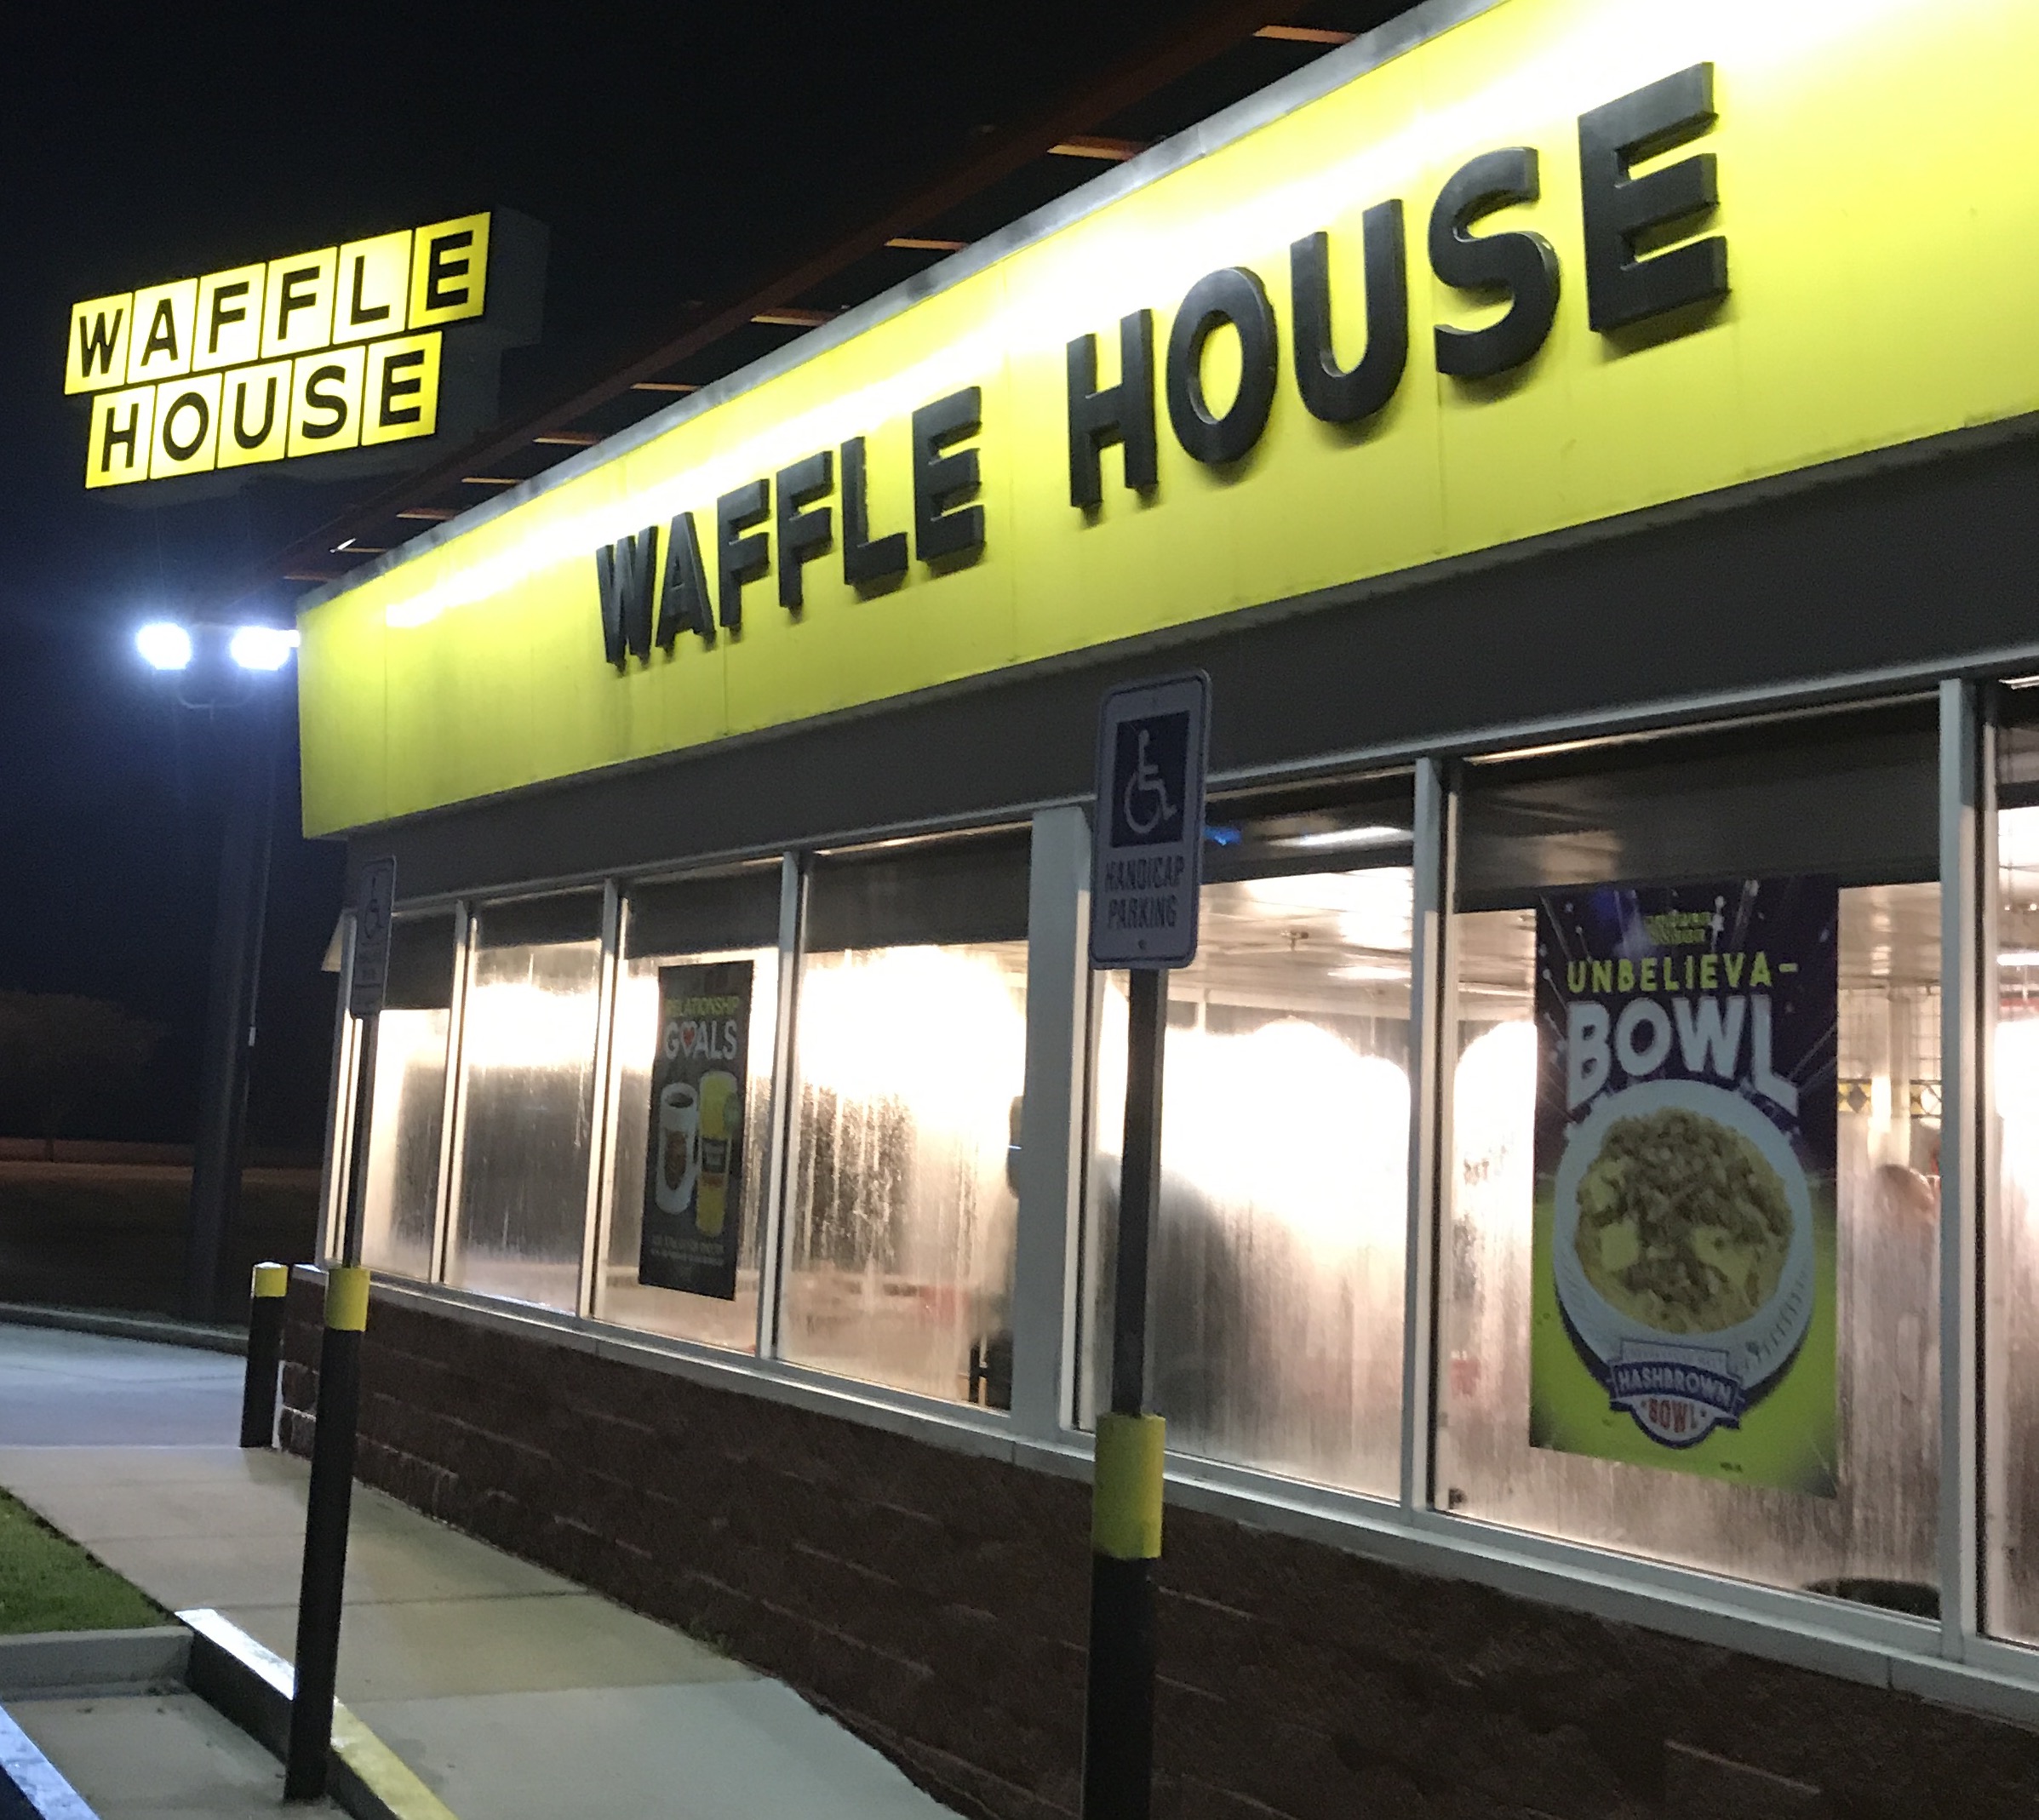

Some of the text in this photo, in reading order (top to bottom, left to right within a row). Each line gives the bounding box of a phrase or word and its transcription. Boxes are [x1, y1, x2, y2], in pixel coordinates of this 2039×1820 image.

[79, 229, 474, 379] WAFFLE
[596, 60, 1731, 668] WAFFLE HOUSE
[100, 349, 427, 472] HOUSE
[1105, 856, 1185, 892] HANDICAP
[1108, 895, 1178, 929] PARKING
[1566, 950, 1799, 993] UNBELIEVA-
[1566, 993, 1798, 1119] BOWL
[1618, 1366, 1732, 1408] HASHBROWN
[1648, 1397, 1698, 1434] BOWL
